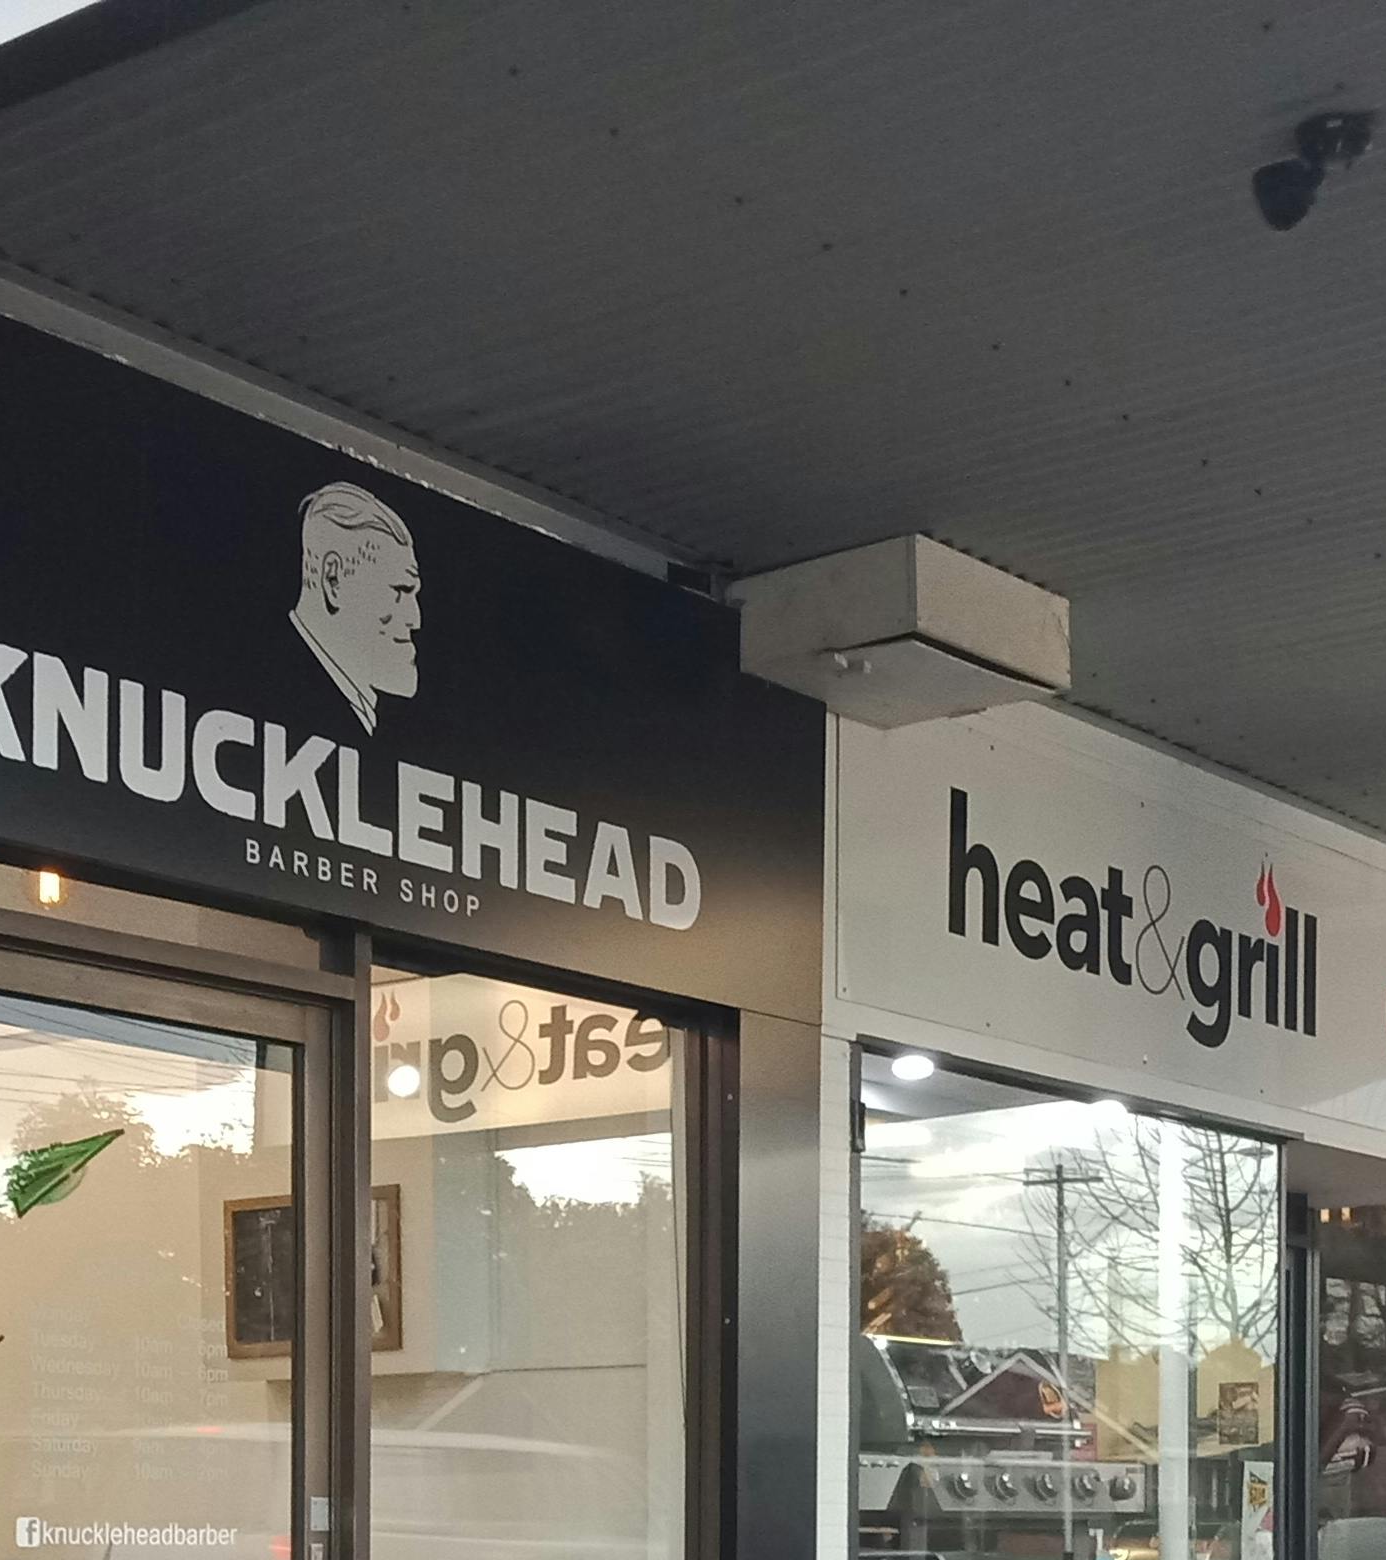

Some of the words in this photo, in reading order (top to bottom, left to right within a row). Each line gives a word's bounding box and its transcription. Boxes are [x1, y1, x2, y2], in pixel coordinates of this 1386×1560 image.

[245, 838, 380, 896] BARBER
[400, 878, 482, 919] SHOP
[949, 786, 1318, 1048] heat&grill
[30, 1353, 119, 1380] Wednesday
[42, 1521, 238, 1546] knuckleheadbarber
